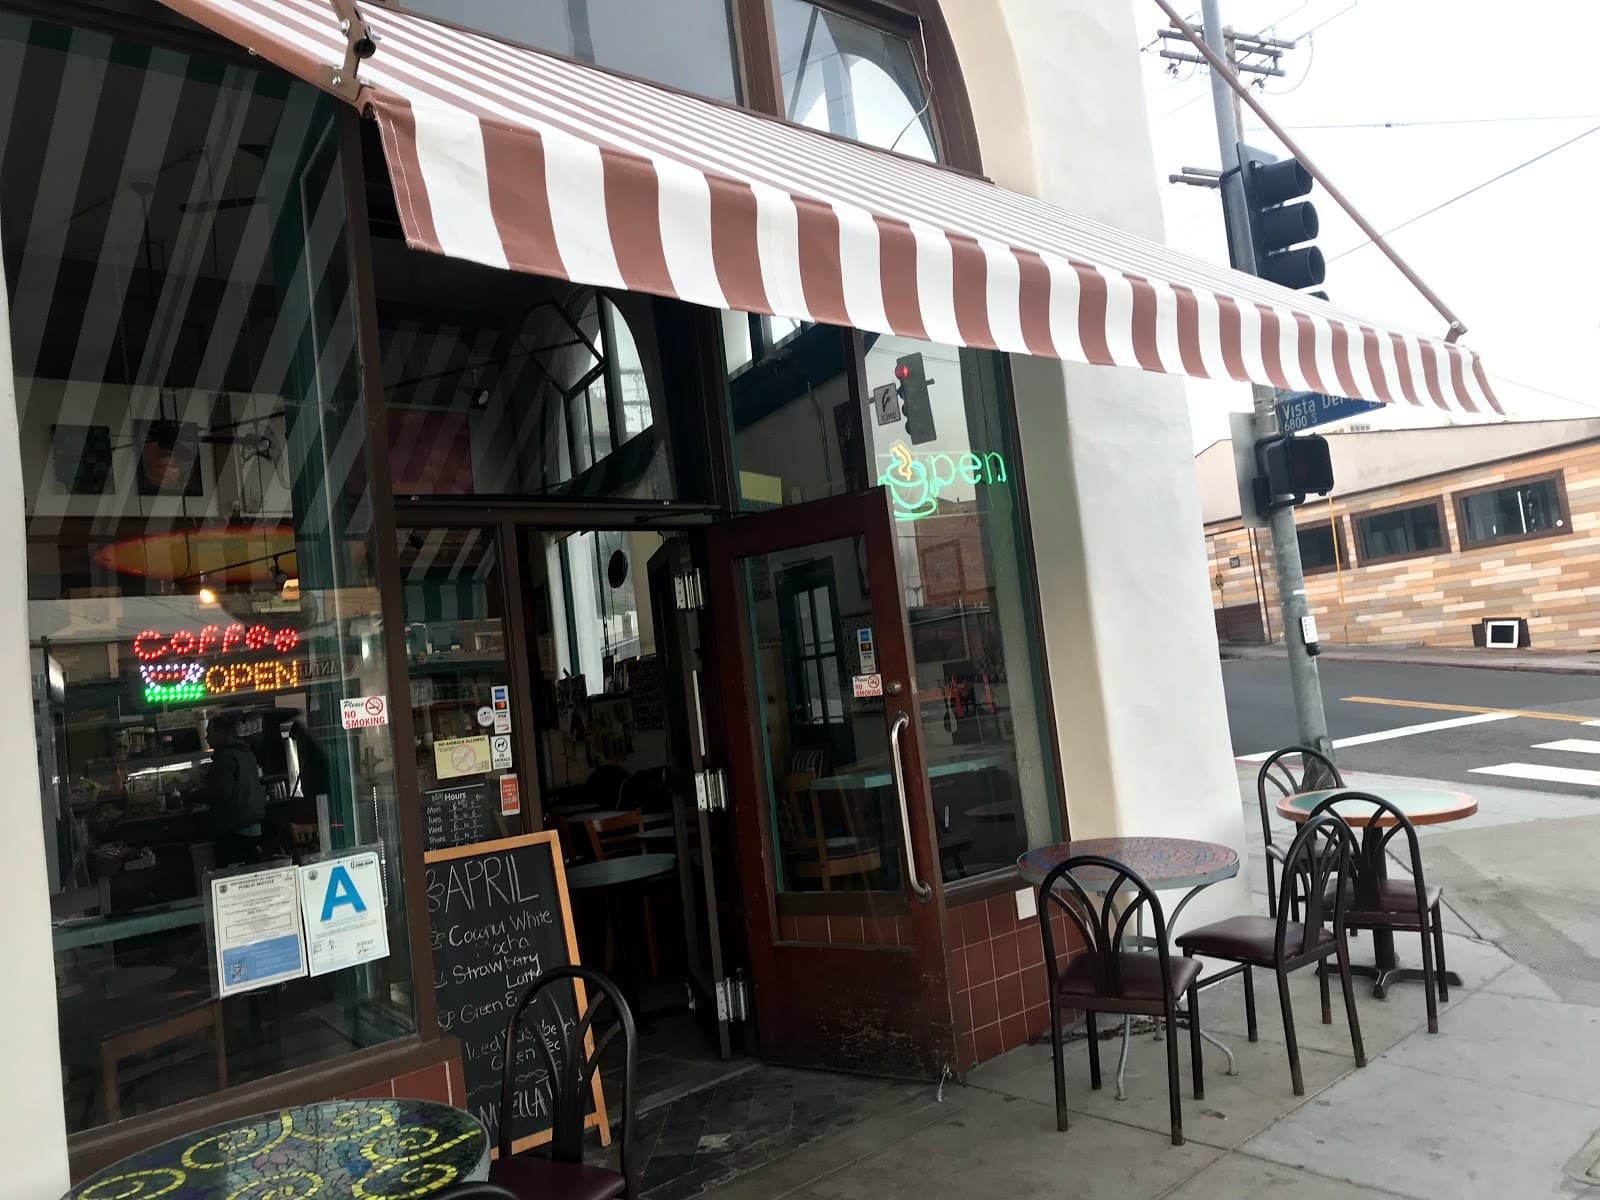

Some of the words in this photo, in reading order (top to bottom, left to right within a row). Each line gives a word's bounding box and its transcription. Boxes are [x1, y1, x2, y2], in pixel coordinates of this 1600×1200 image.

[1282, 400, 1316, 420] Vista
[1284, 416, 1308, 432] 6800
[1311, 412, 1318, 424] S
[134, 623, 299, 661] Coffee
[205, 660, 298, 694] OPEN
[344, 711, 357, 719] NO
[345, 716, 385, 729] SMOKING
[444, 792, 466, 801] Hours
[320, 865, 368, 922] A
[445, 854, 539, 913] APRIL
[509, 909, 553, 932] White
[460, 1000, 504, 1024] Green
